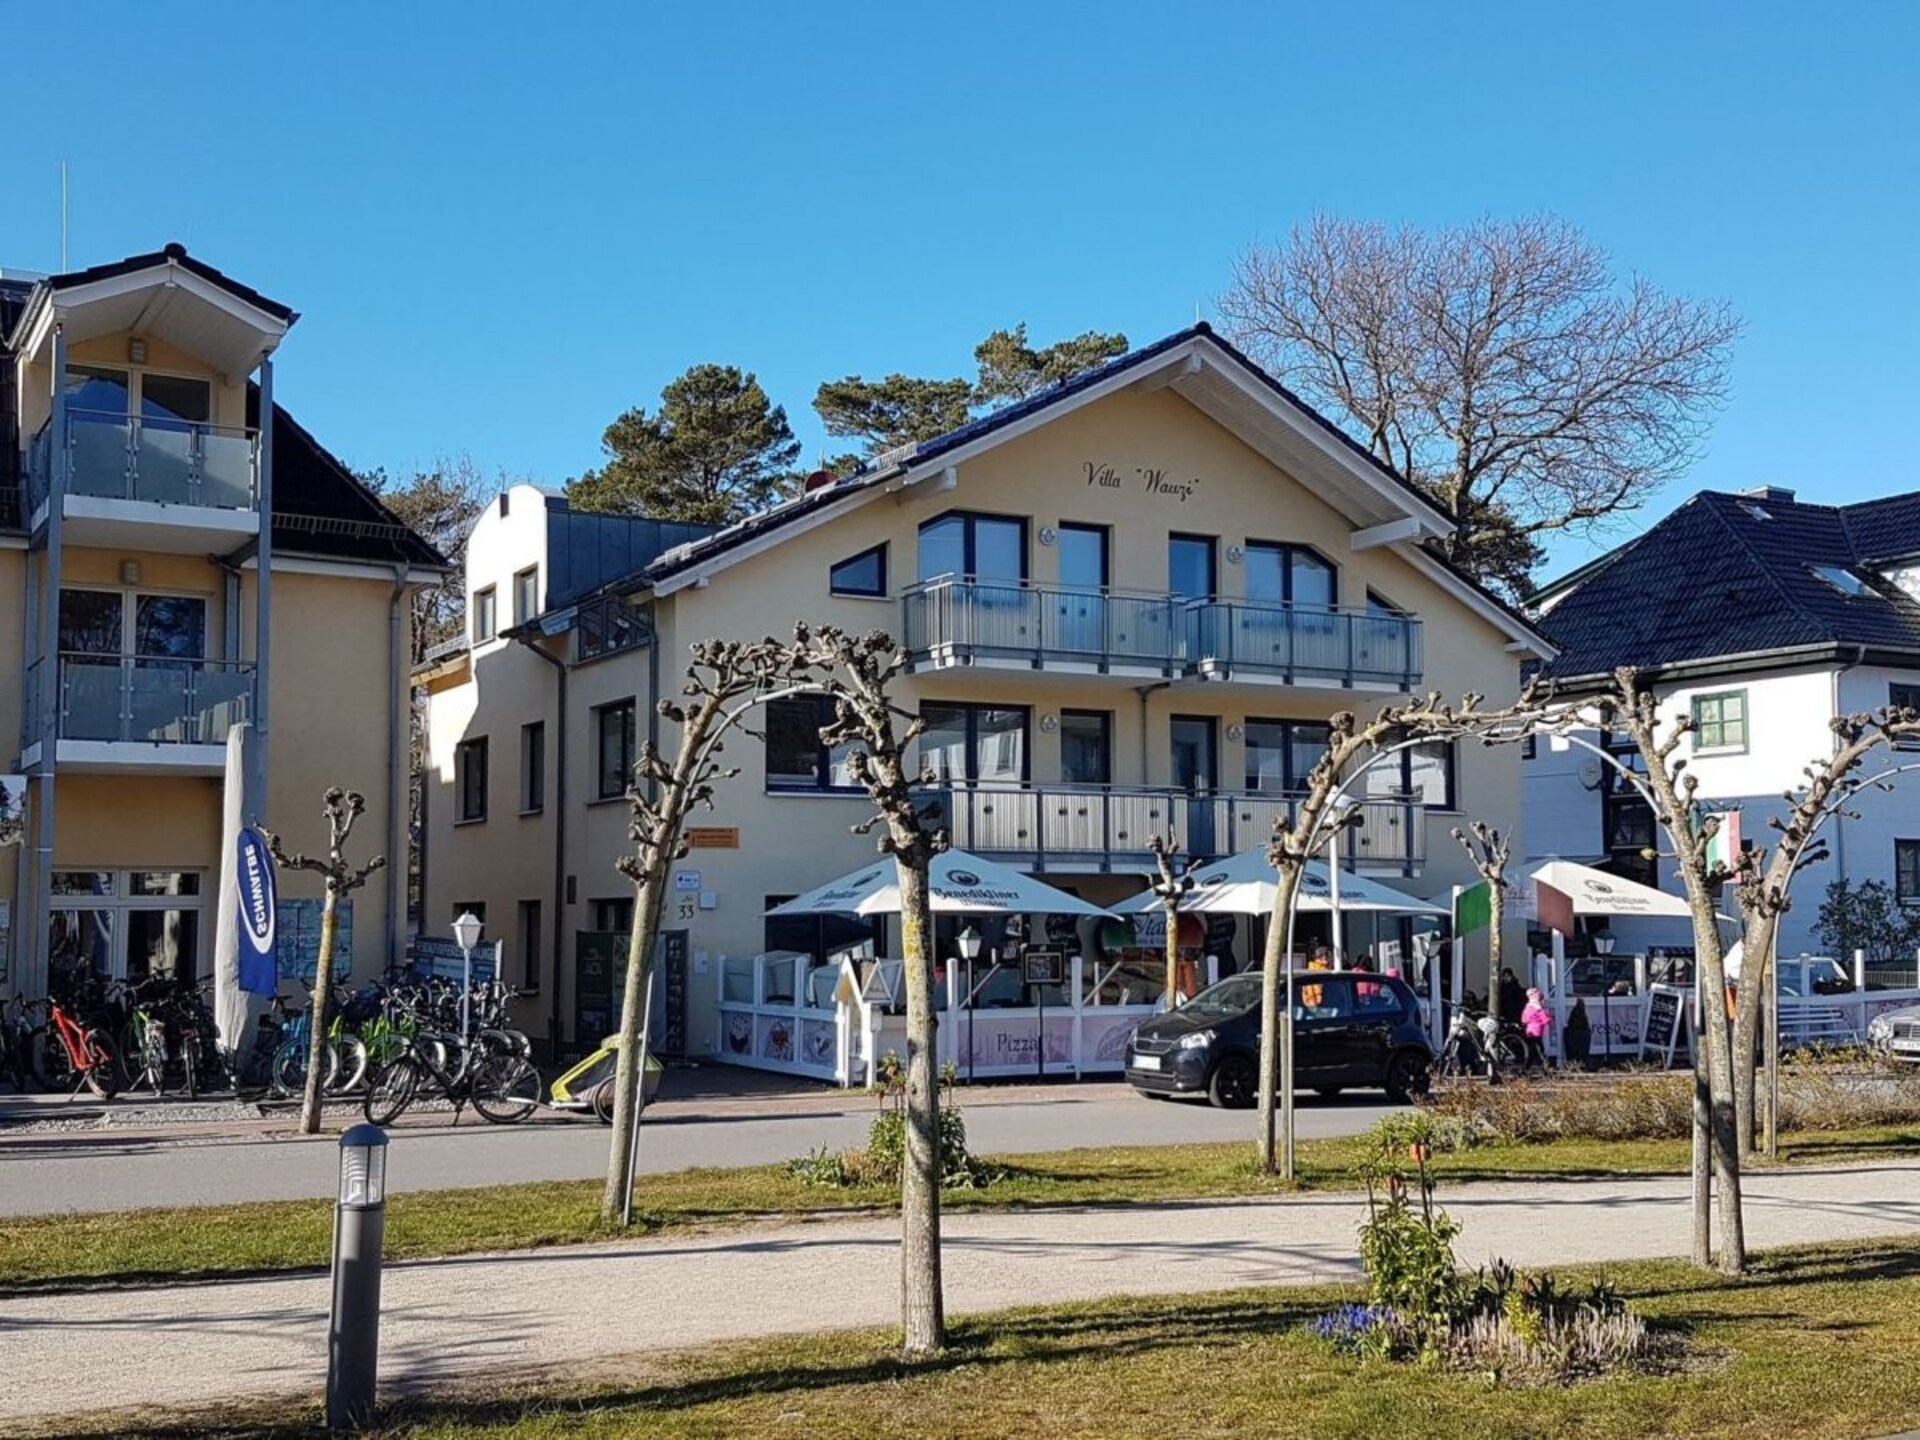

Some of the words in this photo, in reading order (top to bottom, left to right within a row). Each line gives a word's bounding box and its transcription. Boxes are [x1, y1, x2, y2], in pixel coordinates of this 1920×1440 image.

[1083, 461, 1121, 488] Villa
[679, 904, 694, 920] 33
[997, 1031, 1040, 1053] Pizza
